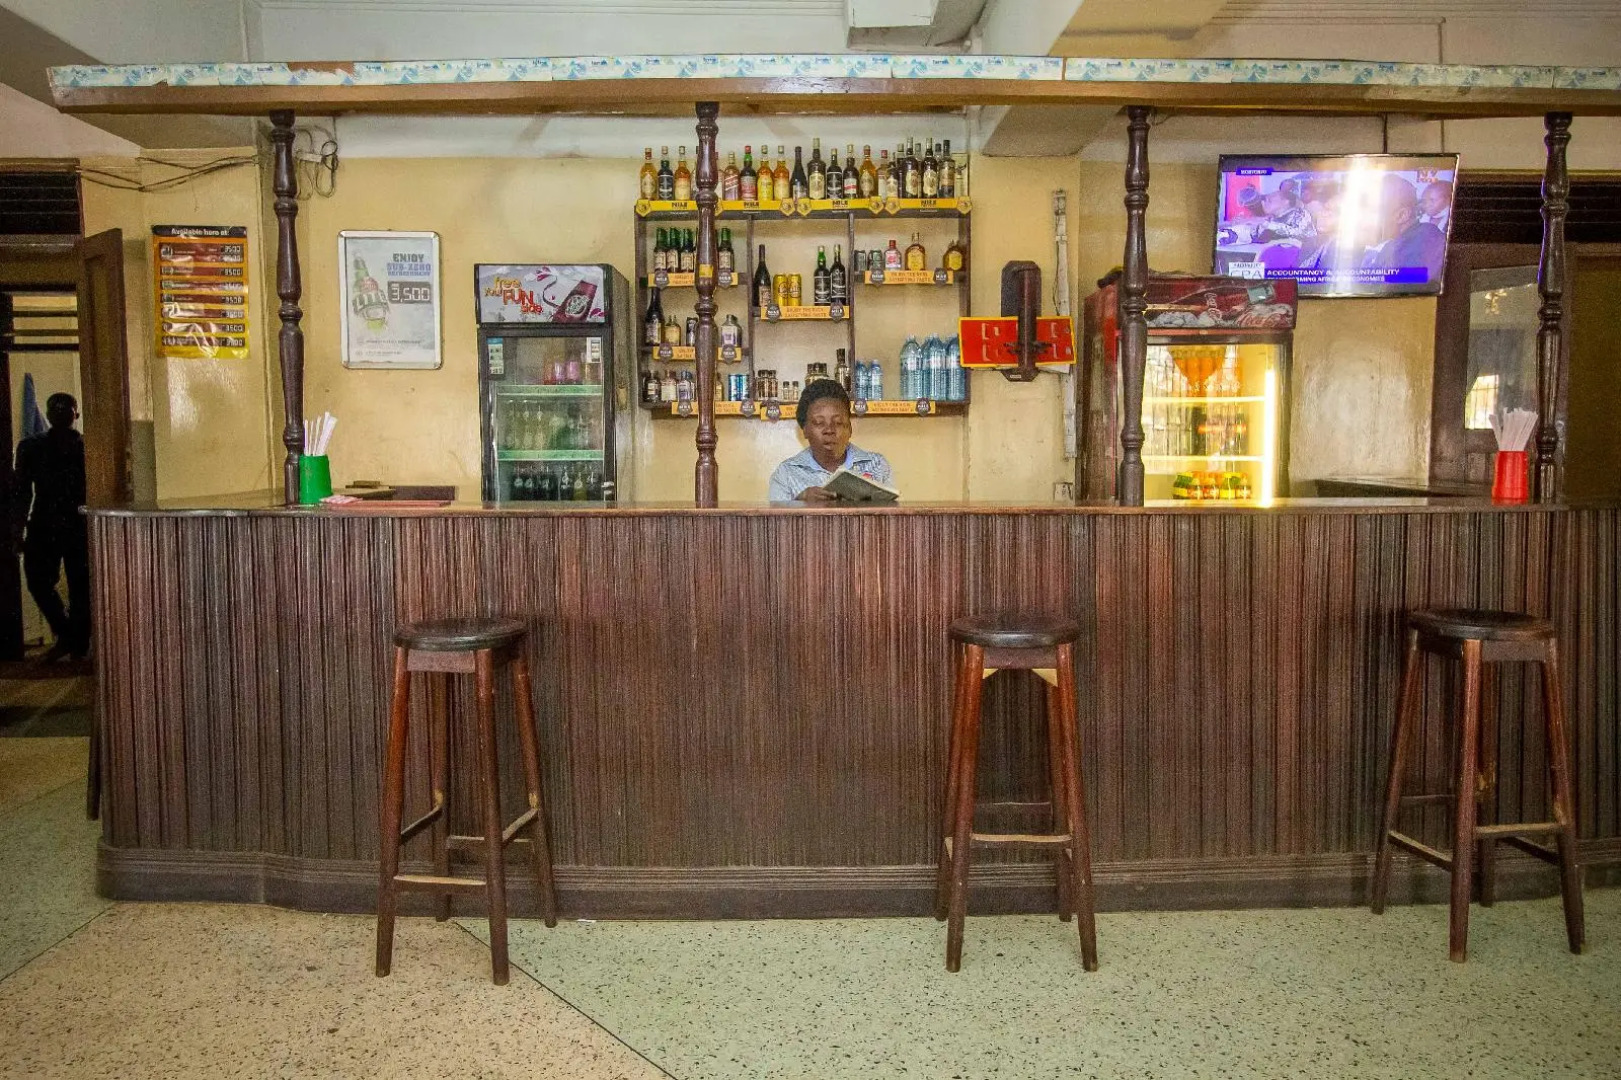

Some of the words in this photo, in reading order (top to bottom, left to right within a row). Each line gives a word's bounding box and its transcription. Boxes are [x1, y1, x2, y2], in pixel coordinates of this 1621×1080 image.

[393, 253, 424, 262] ENJOY
[391, 287, 430, 302] 3,500
[503, 288, 534, 305] FUN
